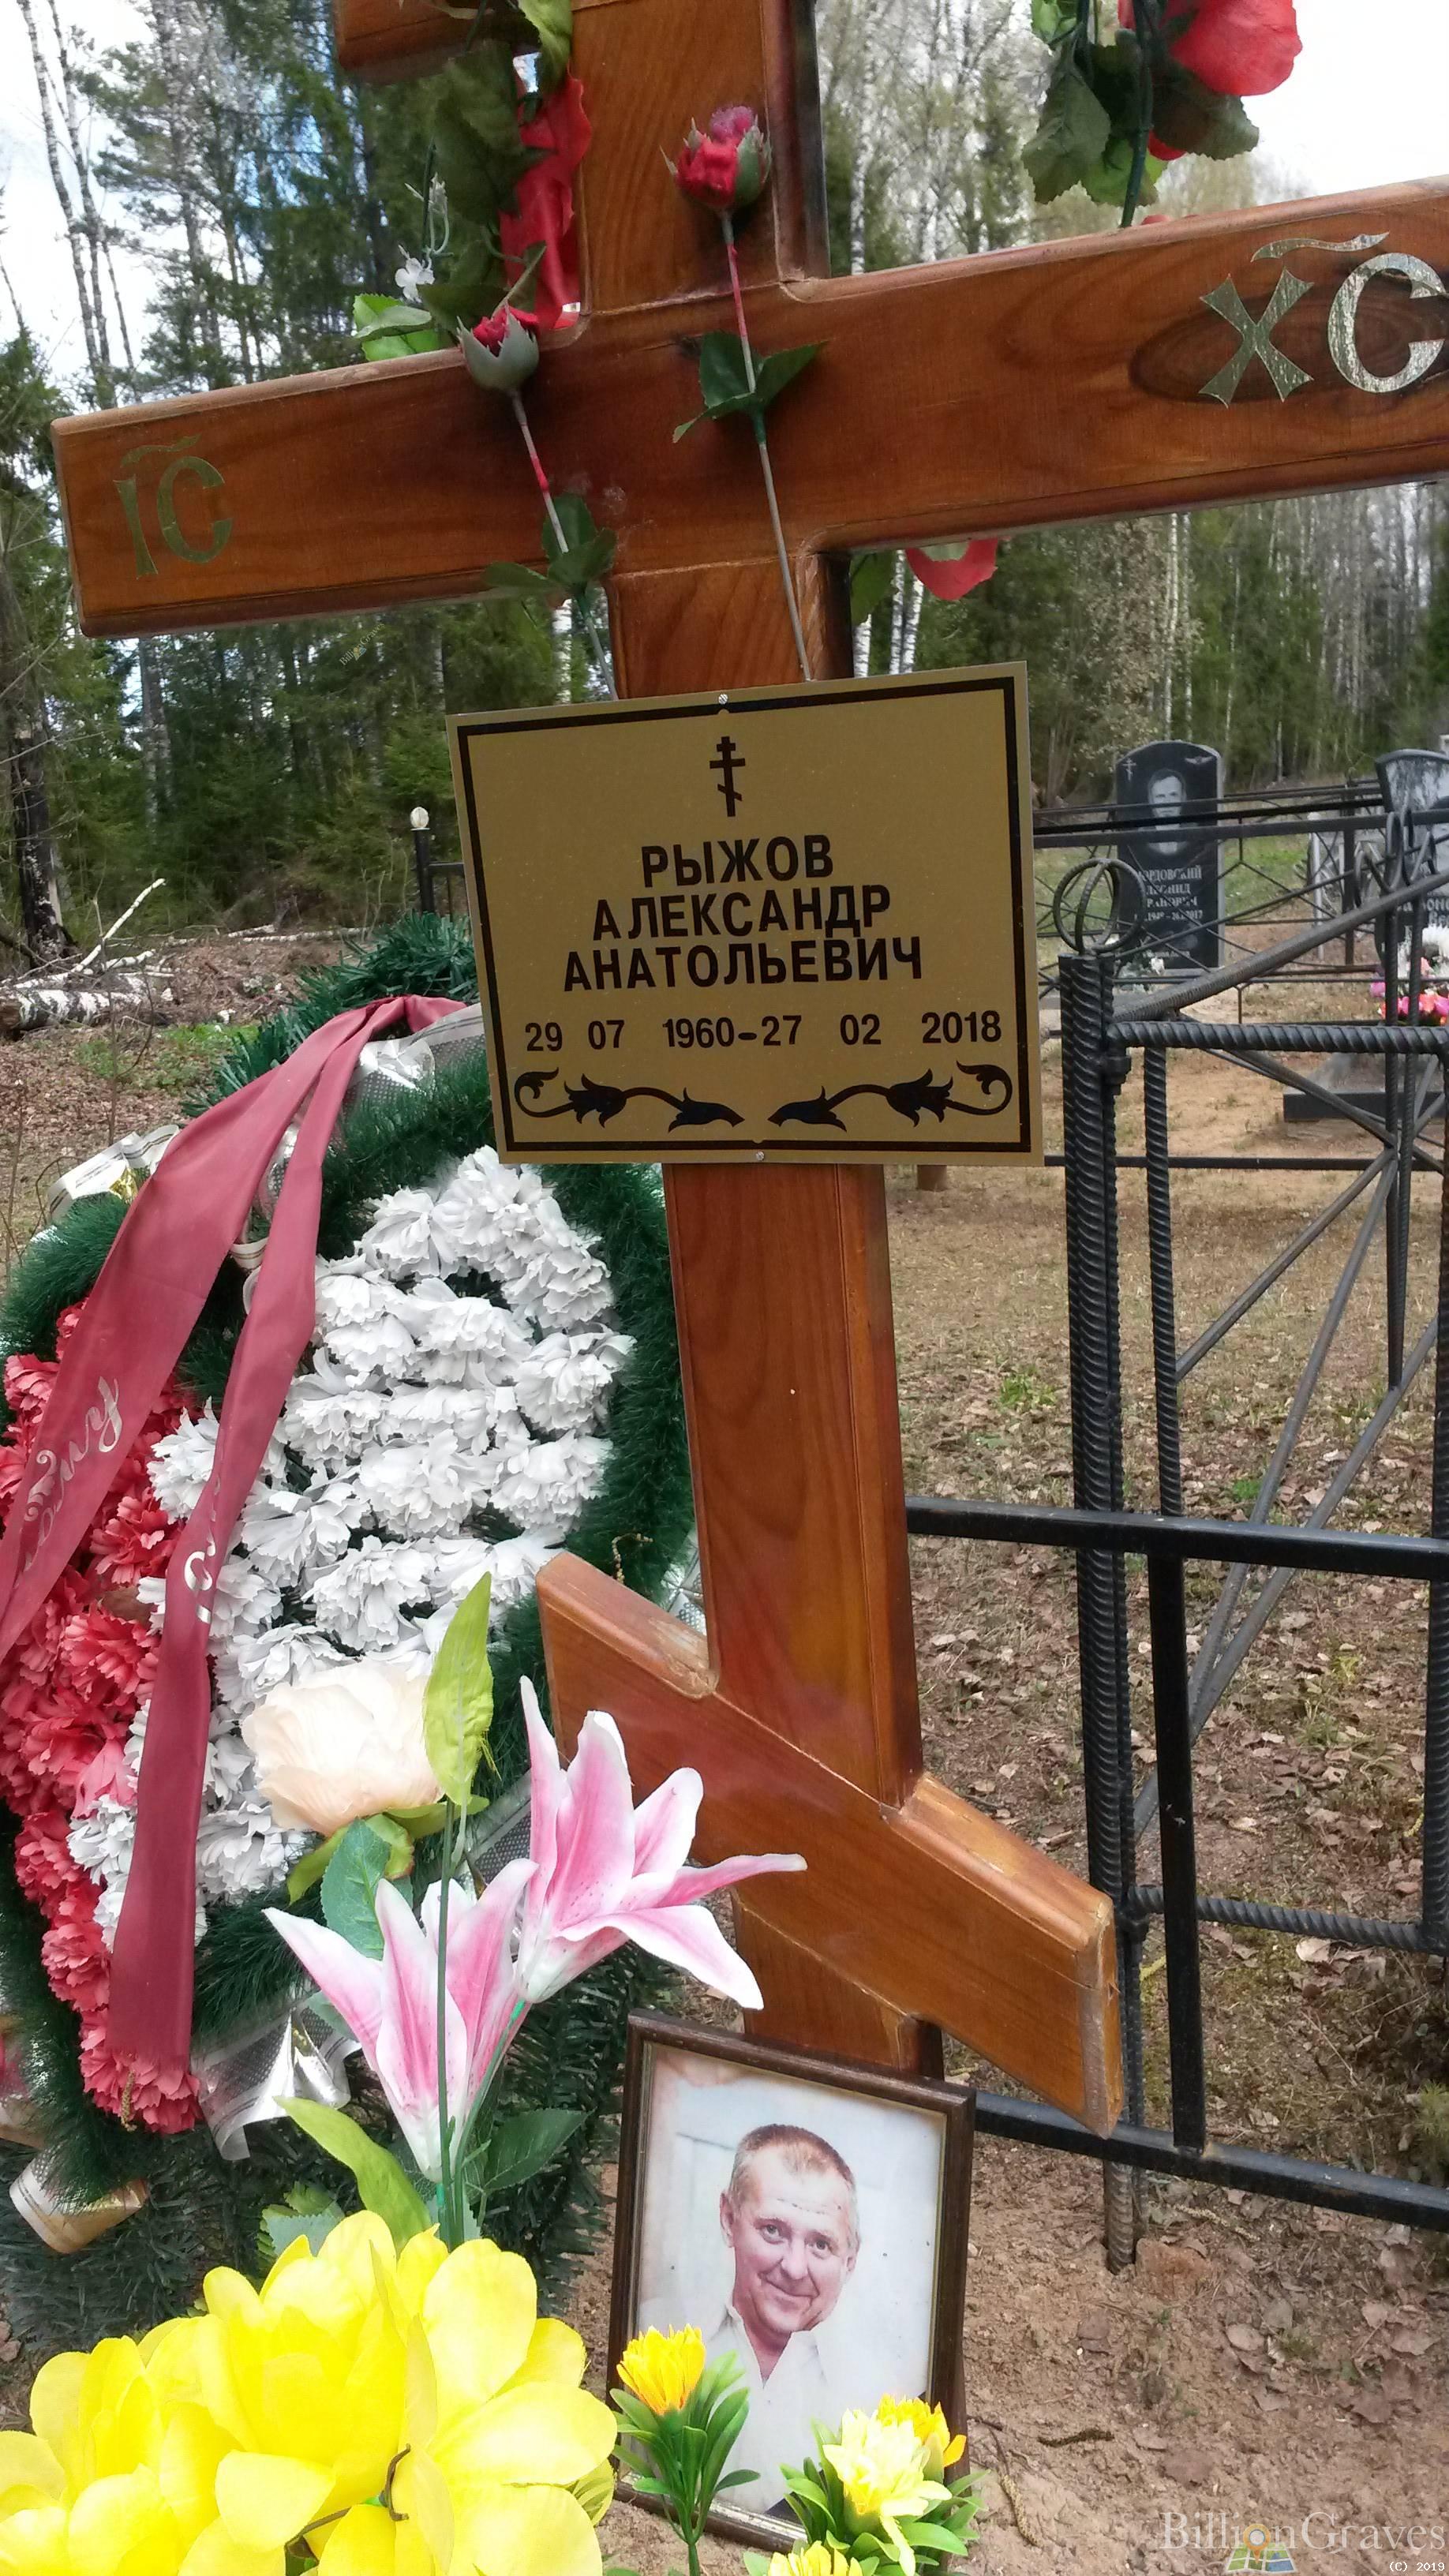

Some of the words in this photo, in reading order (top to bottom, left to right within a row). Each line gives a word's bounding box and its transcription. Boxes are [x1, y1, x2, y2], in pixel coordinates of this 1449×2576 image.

[641, 834, 833, 888] РЫЖОВ
[593, 884, 891, 941] АЛЕКСАНДР
[564, 937, 923, 992] АНАТОЛЬЕВИЧ
[525, 1021, 564, 1052] 29
[588, 1020, 625, 1050] 07
[840, 1014, 882, 1046] 02
[921, 1010, 1002, 1044] 2018
